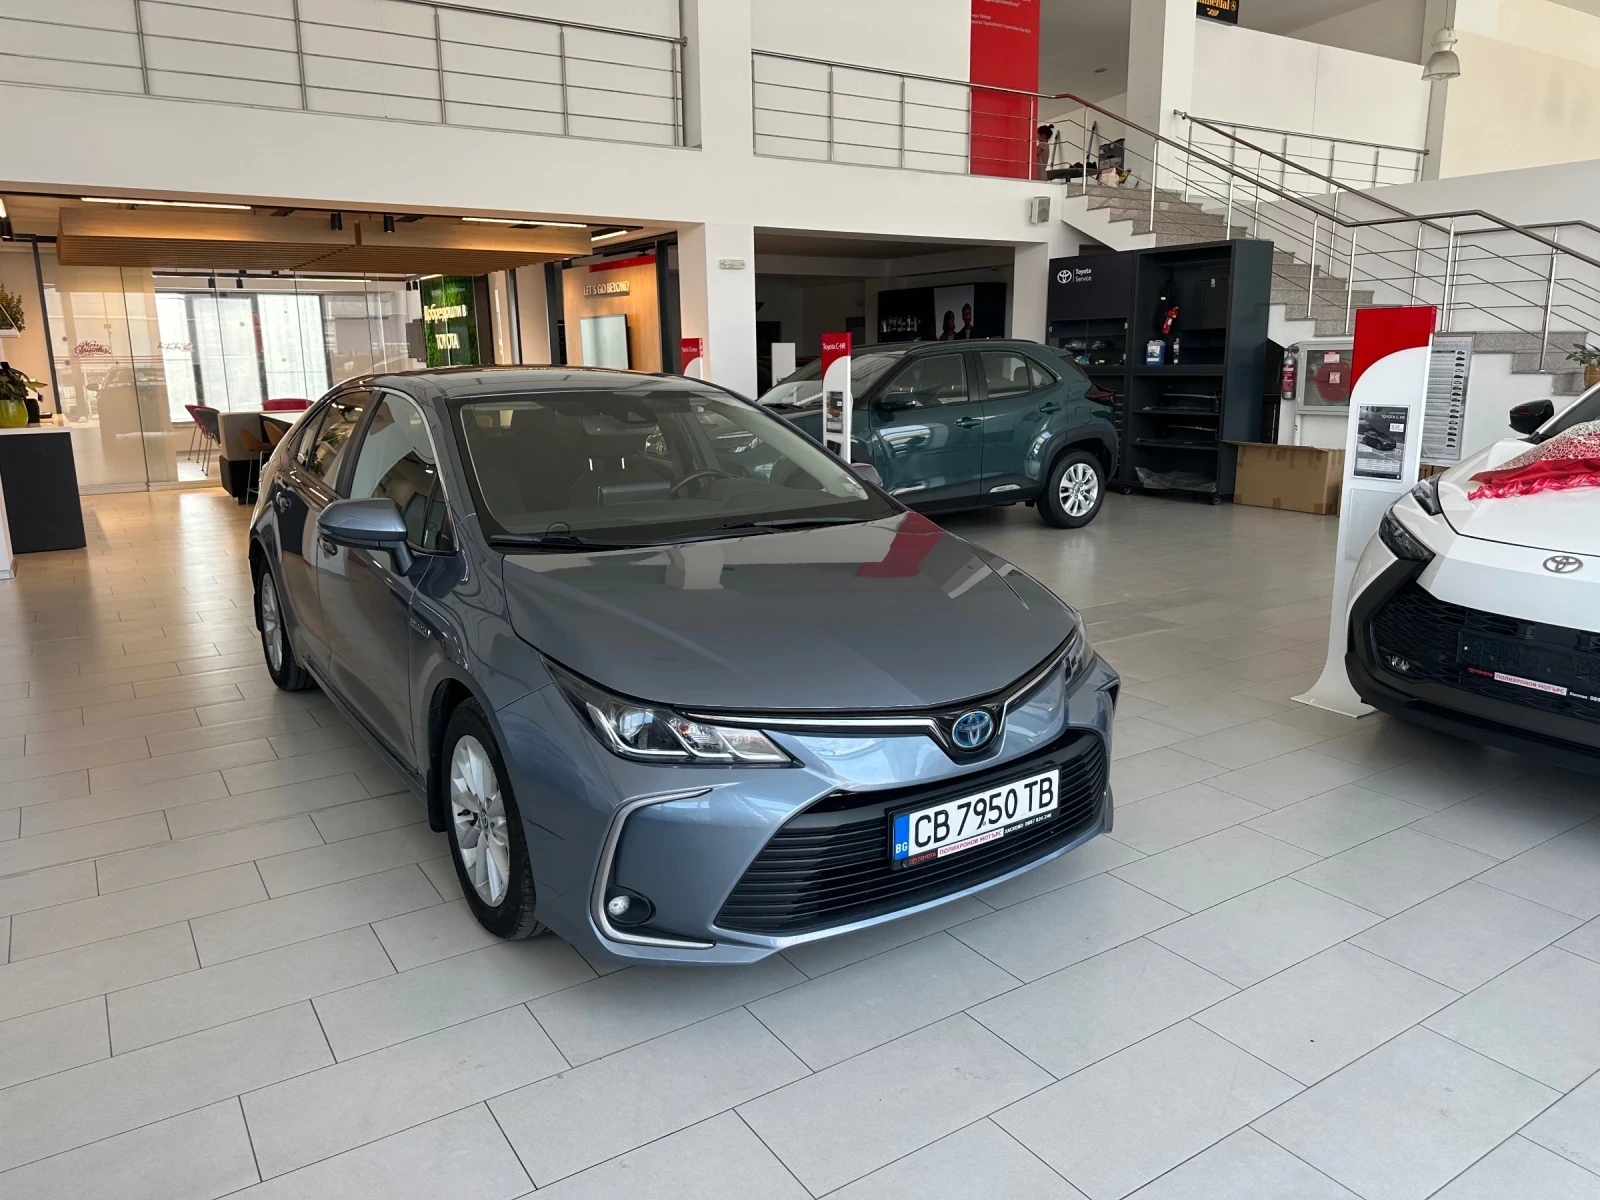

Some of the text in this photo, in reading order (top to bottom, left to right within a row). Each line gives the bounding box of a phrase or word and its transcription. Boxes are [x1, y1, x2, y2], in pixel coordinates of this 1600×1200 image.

[1075, 268, 1092, 276] Toyota
[598, 283, 606, 294] GO
[607, 280, 629, 293] BEYOND
[436, 333, 460, 349] TOYOTA
[1475, 669, 1493, 677] TOYOTA
[1495, 673, 1565, 694] ПОЛИХРОНОВ МОТЪРС
[914, 777, 1054, 848] CB 7950 TB
[895, 842, 908, 854] BG
[939, 831, 1002, 855] ПОЛИХРОНОВ МОТЪРС
[917, 852, 937, 863] TOYOTA
